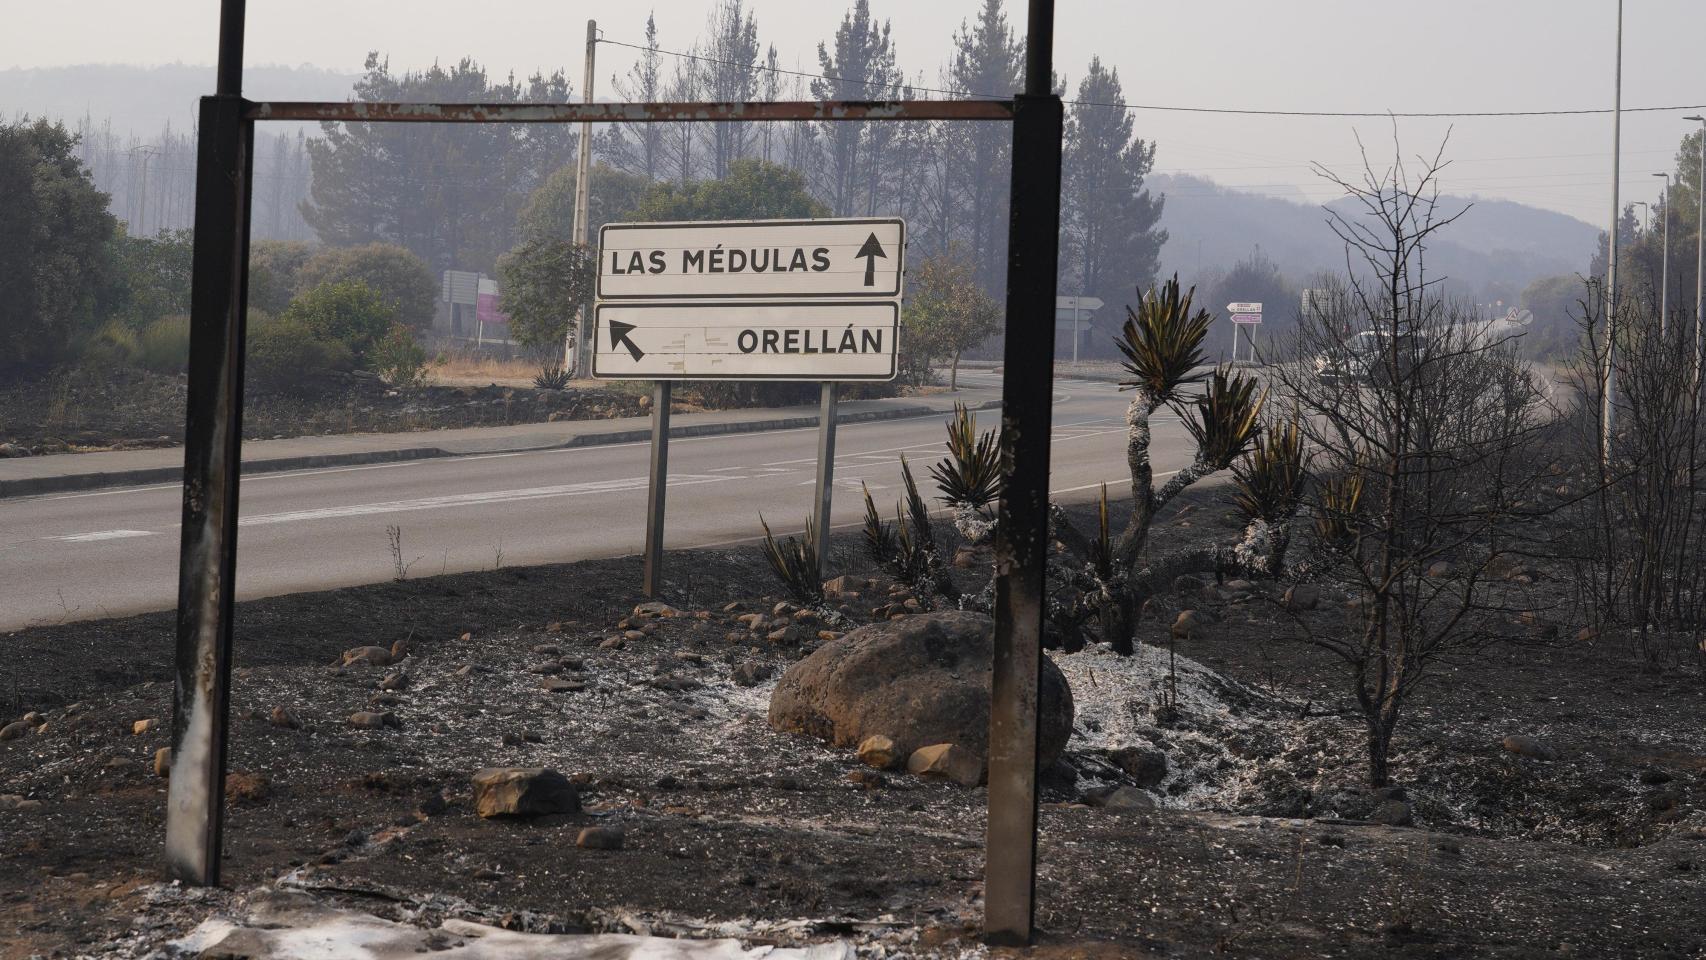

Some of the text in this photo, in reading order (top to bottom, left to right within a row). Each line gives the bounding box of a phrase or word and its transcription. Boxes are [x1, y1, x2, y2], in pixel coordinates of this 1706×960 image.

[612, 244, 831, 275] LAS MÉDULAS
[737, 324, 883, 355] ORELLÁN
